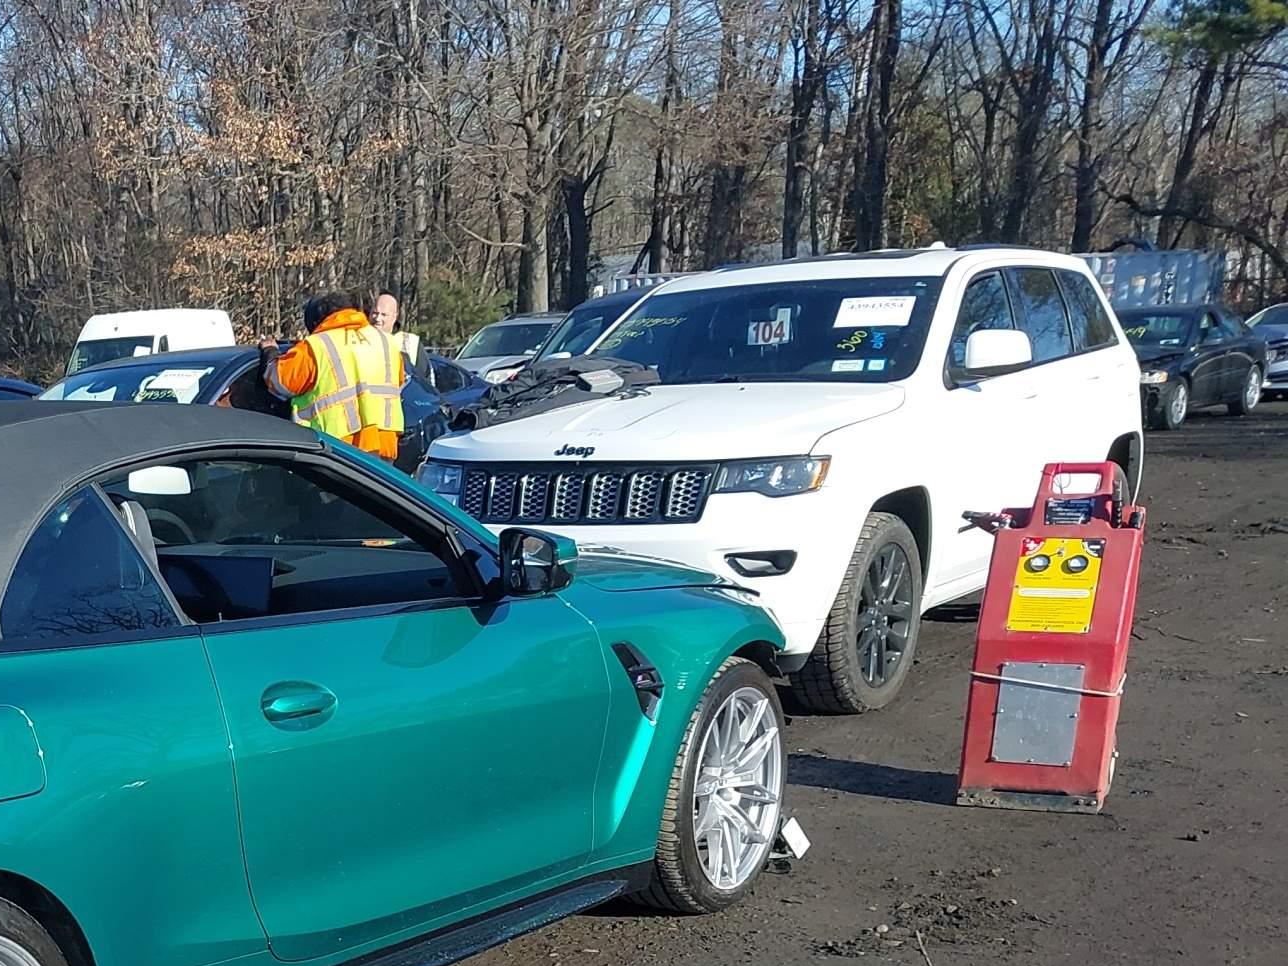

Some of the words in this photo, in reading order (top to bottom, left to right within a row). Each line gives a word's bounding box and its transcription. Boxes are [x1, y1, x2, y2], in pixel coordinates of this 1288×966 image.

[752, 320, 786, 343] 104
[836, 330, 868, 353] 360
[554, 443, 595, 458] Jeep
